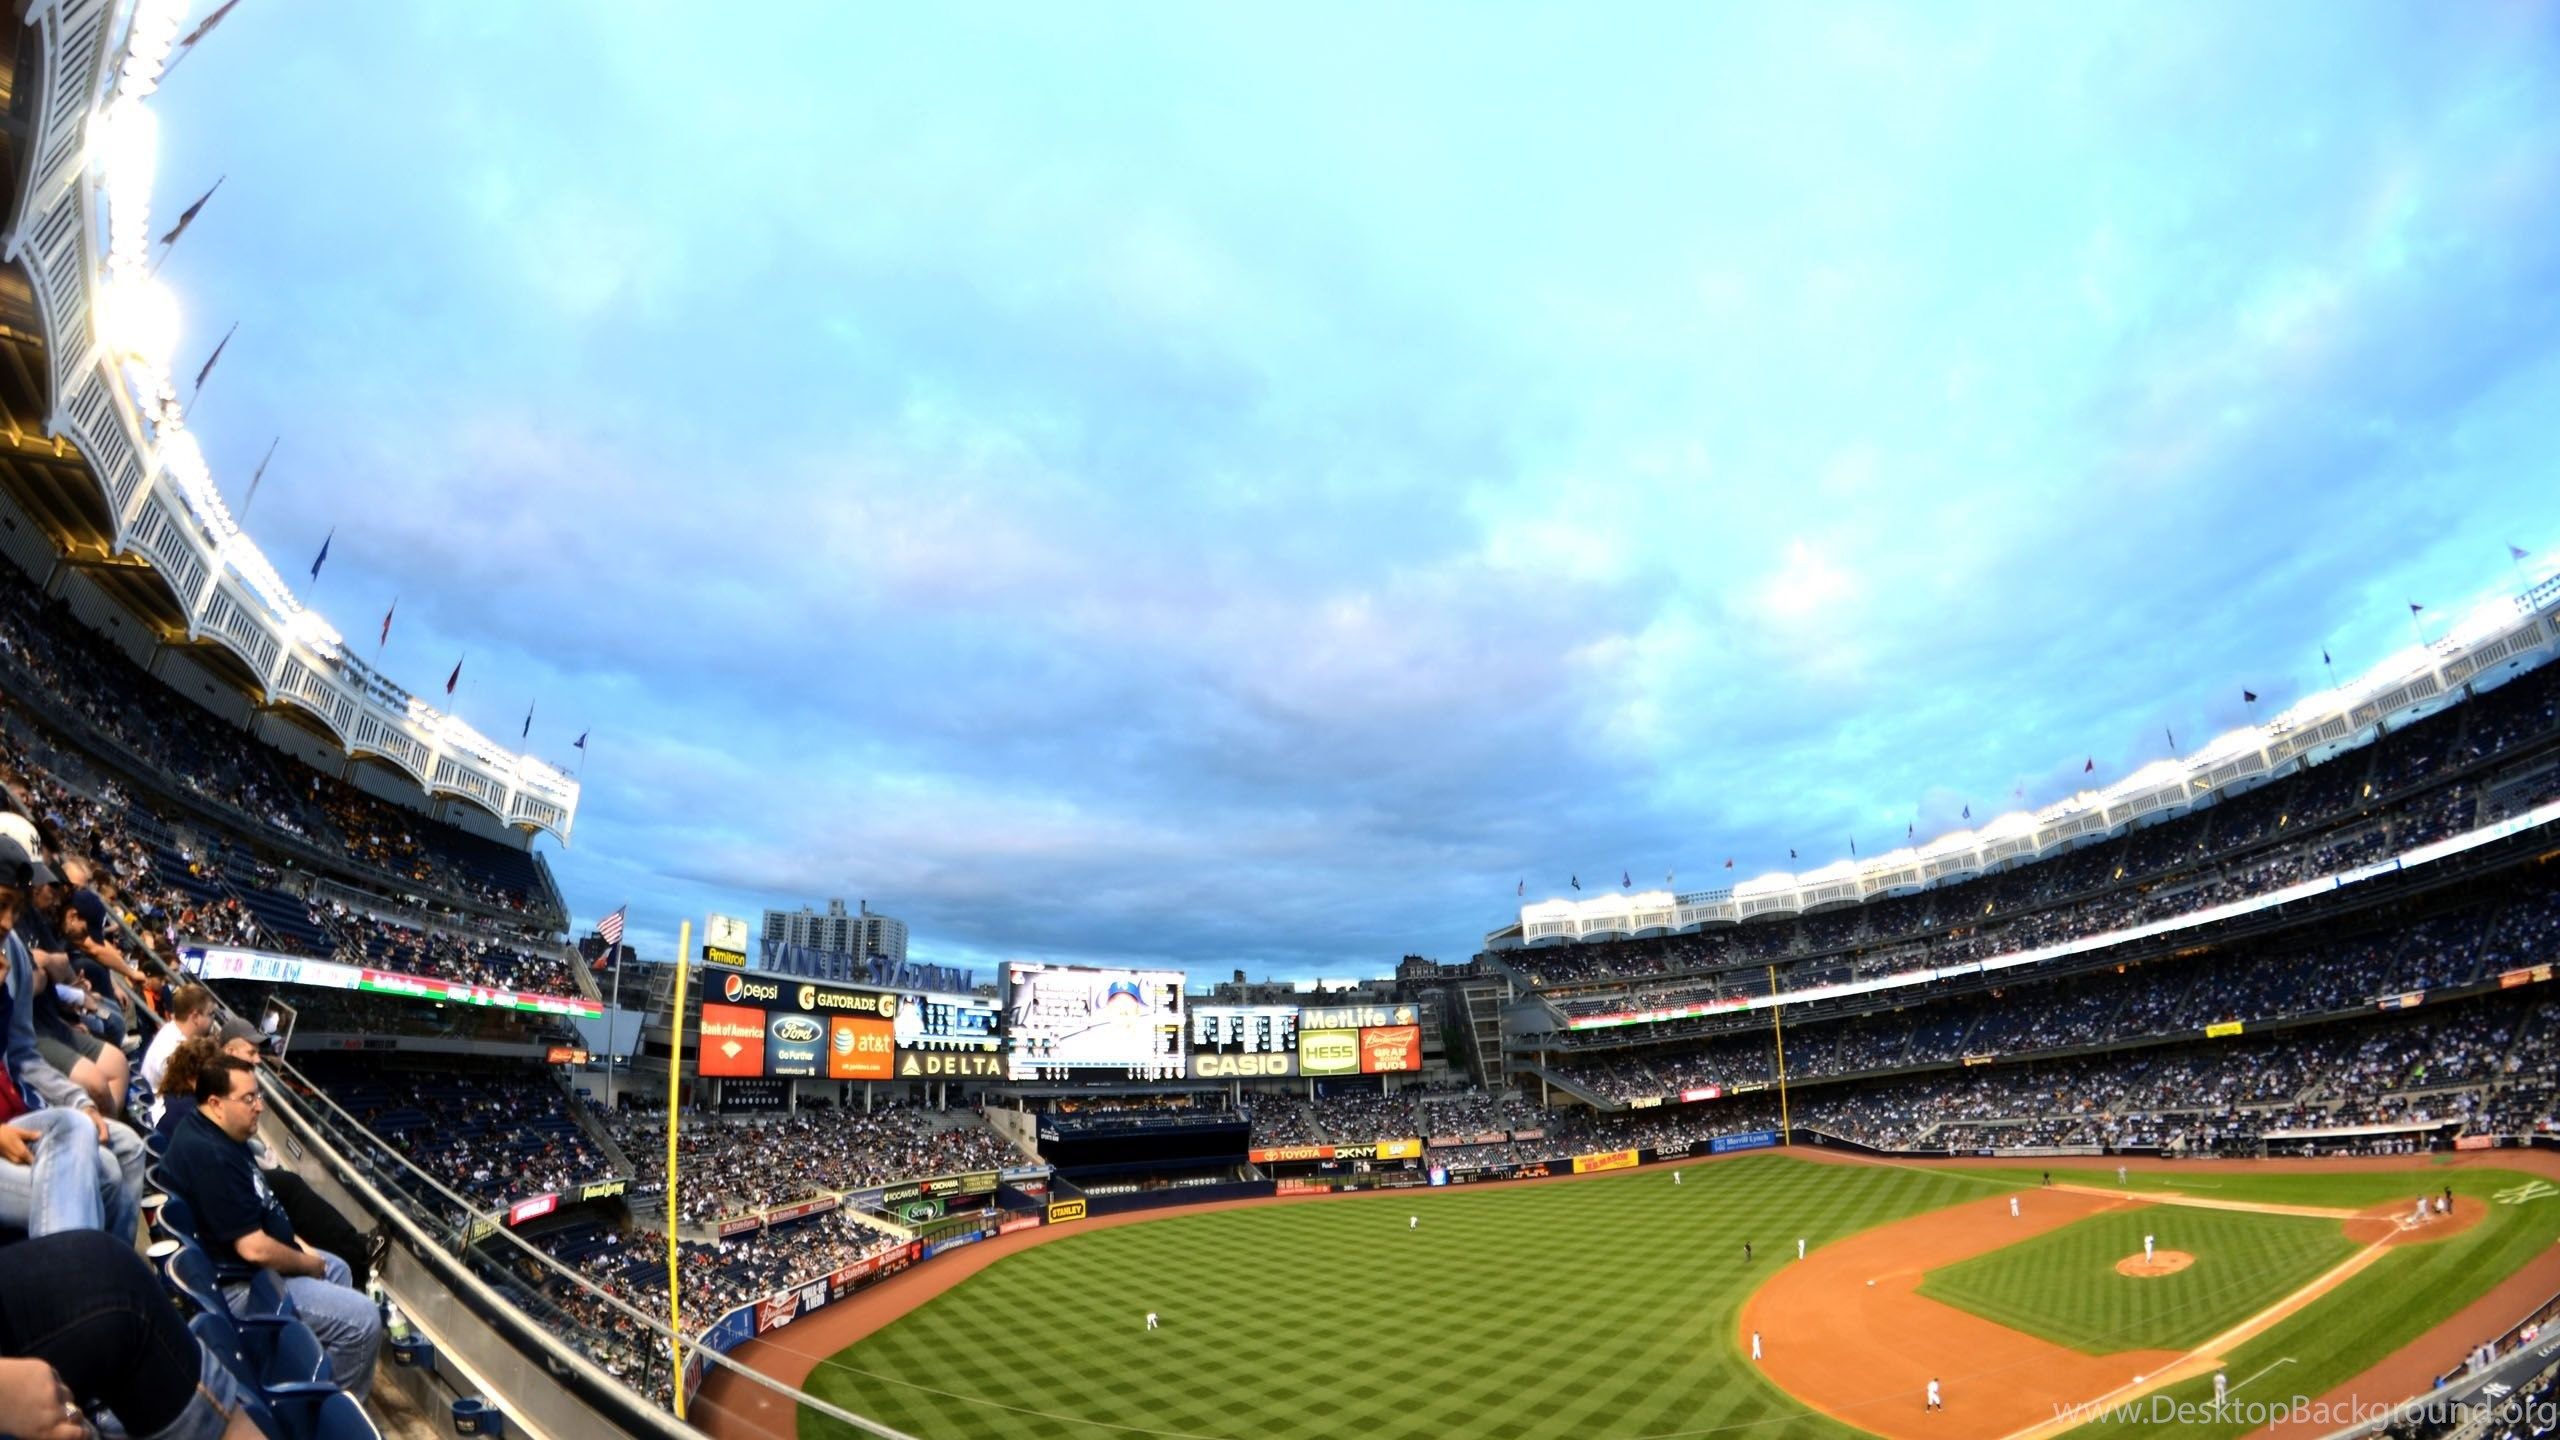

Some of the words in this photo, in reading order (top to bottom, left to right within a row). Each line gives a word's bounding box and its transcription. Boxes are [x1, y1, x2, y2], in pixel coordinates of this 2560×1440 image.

[708, 947, 745, 967] Armitron
[760, 938, 852, 982] YANKEE
[866, 953, 973, 993] STADIUM
[743, 984, 778, 1001] pepsi
[817, 993, 876, 1012] GATORADE
[1304, 1007, 1388, 1029] MetLife
[701, 1021, 721, 1036] Bank
[721, 1024, 731, 1037] of
[731, 1024, 765, 1039] America
[781, 1019, 813, 1041] Ford
[858, 1033, 891, 1054] at&t
[778, 1050, 789, 1060] Go
[1305, 1045, 1353, 1060] HESS
[1373, 1047, 1407, 1057] GRAB
[927, 1056, 1001, 1075] DELTA
[1196, 1054, 1289, 1077] CASIO
[1375, 1061, 1407, 1070] BUDS
[1726, 1136, 1748, 1145] Merrill
[1749, 1133, 1768, 1144] Lynch
[1280, 1150, 1320, 1160] TOYOTA
[1334, 1146, 1377, 1159] DKNY
[1656, 1143, 1692, 1156] SONY
[1600, 1153, 1629, 1166] MASON
[930, 1180, 959, 1191] YOKOHAMA
[888, 1188, 919, 1200] ROCAWEAR
[1052, 1204, 1081, 1217] STANLEY
